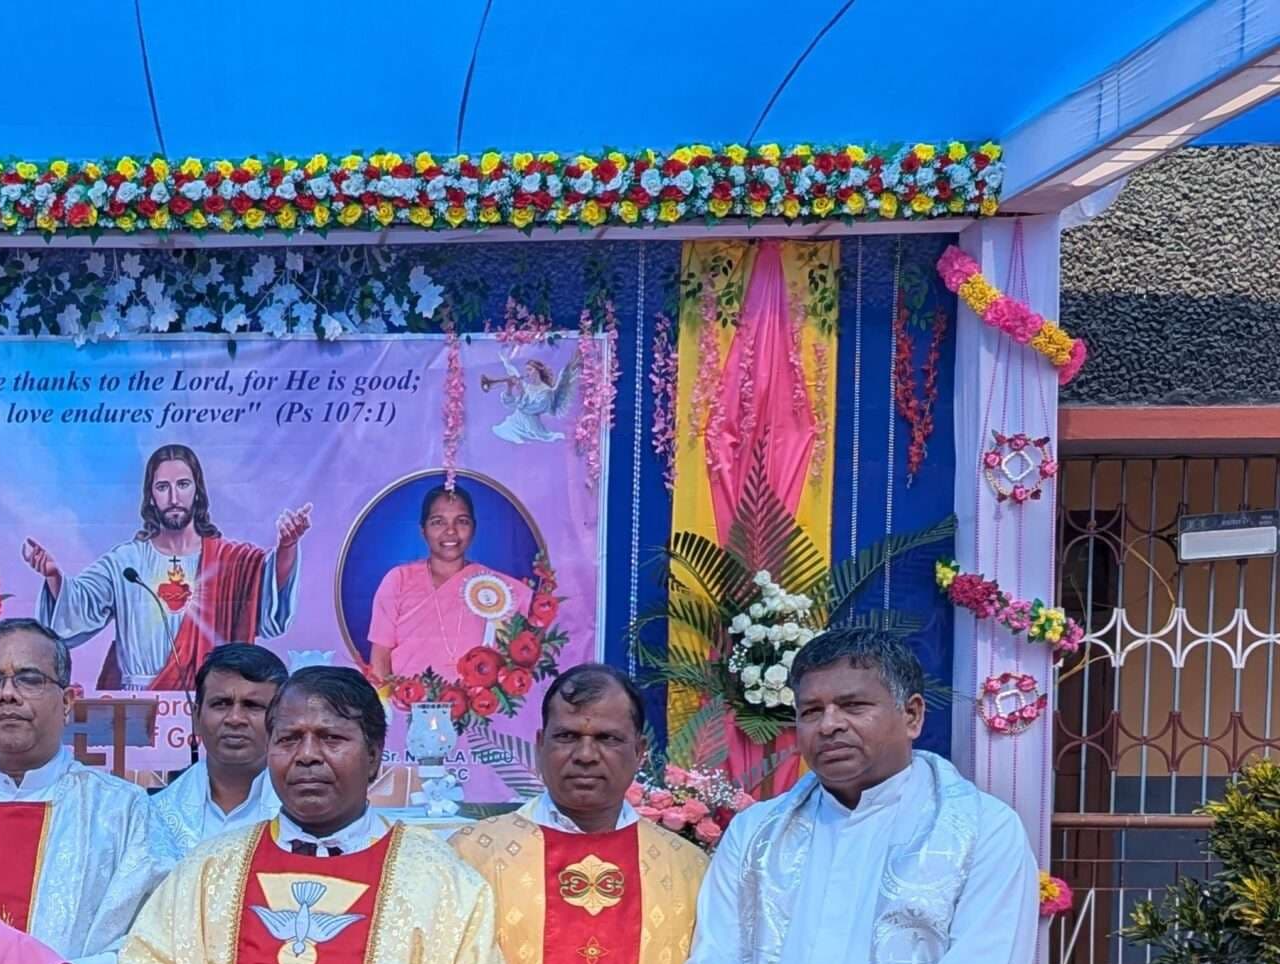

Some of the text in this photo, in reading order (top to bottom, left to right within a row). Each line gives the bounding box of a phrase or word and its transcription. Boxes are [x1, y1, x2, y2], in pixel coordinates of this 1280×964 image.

[13, 370, 92, 392] thanks
[98, 373, 120, 392] to
[127, 370, 165, 392] the
[170, 369, 234, 395] Lord,
[238, 369, 279, 397] for
[284, 369, 320, 391] He
[327, 369, 346, 391] is
[352, 368, 421, 397] good;
[7, 402, 54, 424] love
[61, 402, 154, 424] endures
[156, 401, 261, 429] forever"
[276, 401, 314, 426] (Ps
[321, 401, 397, 426] 107:1)
